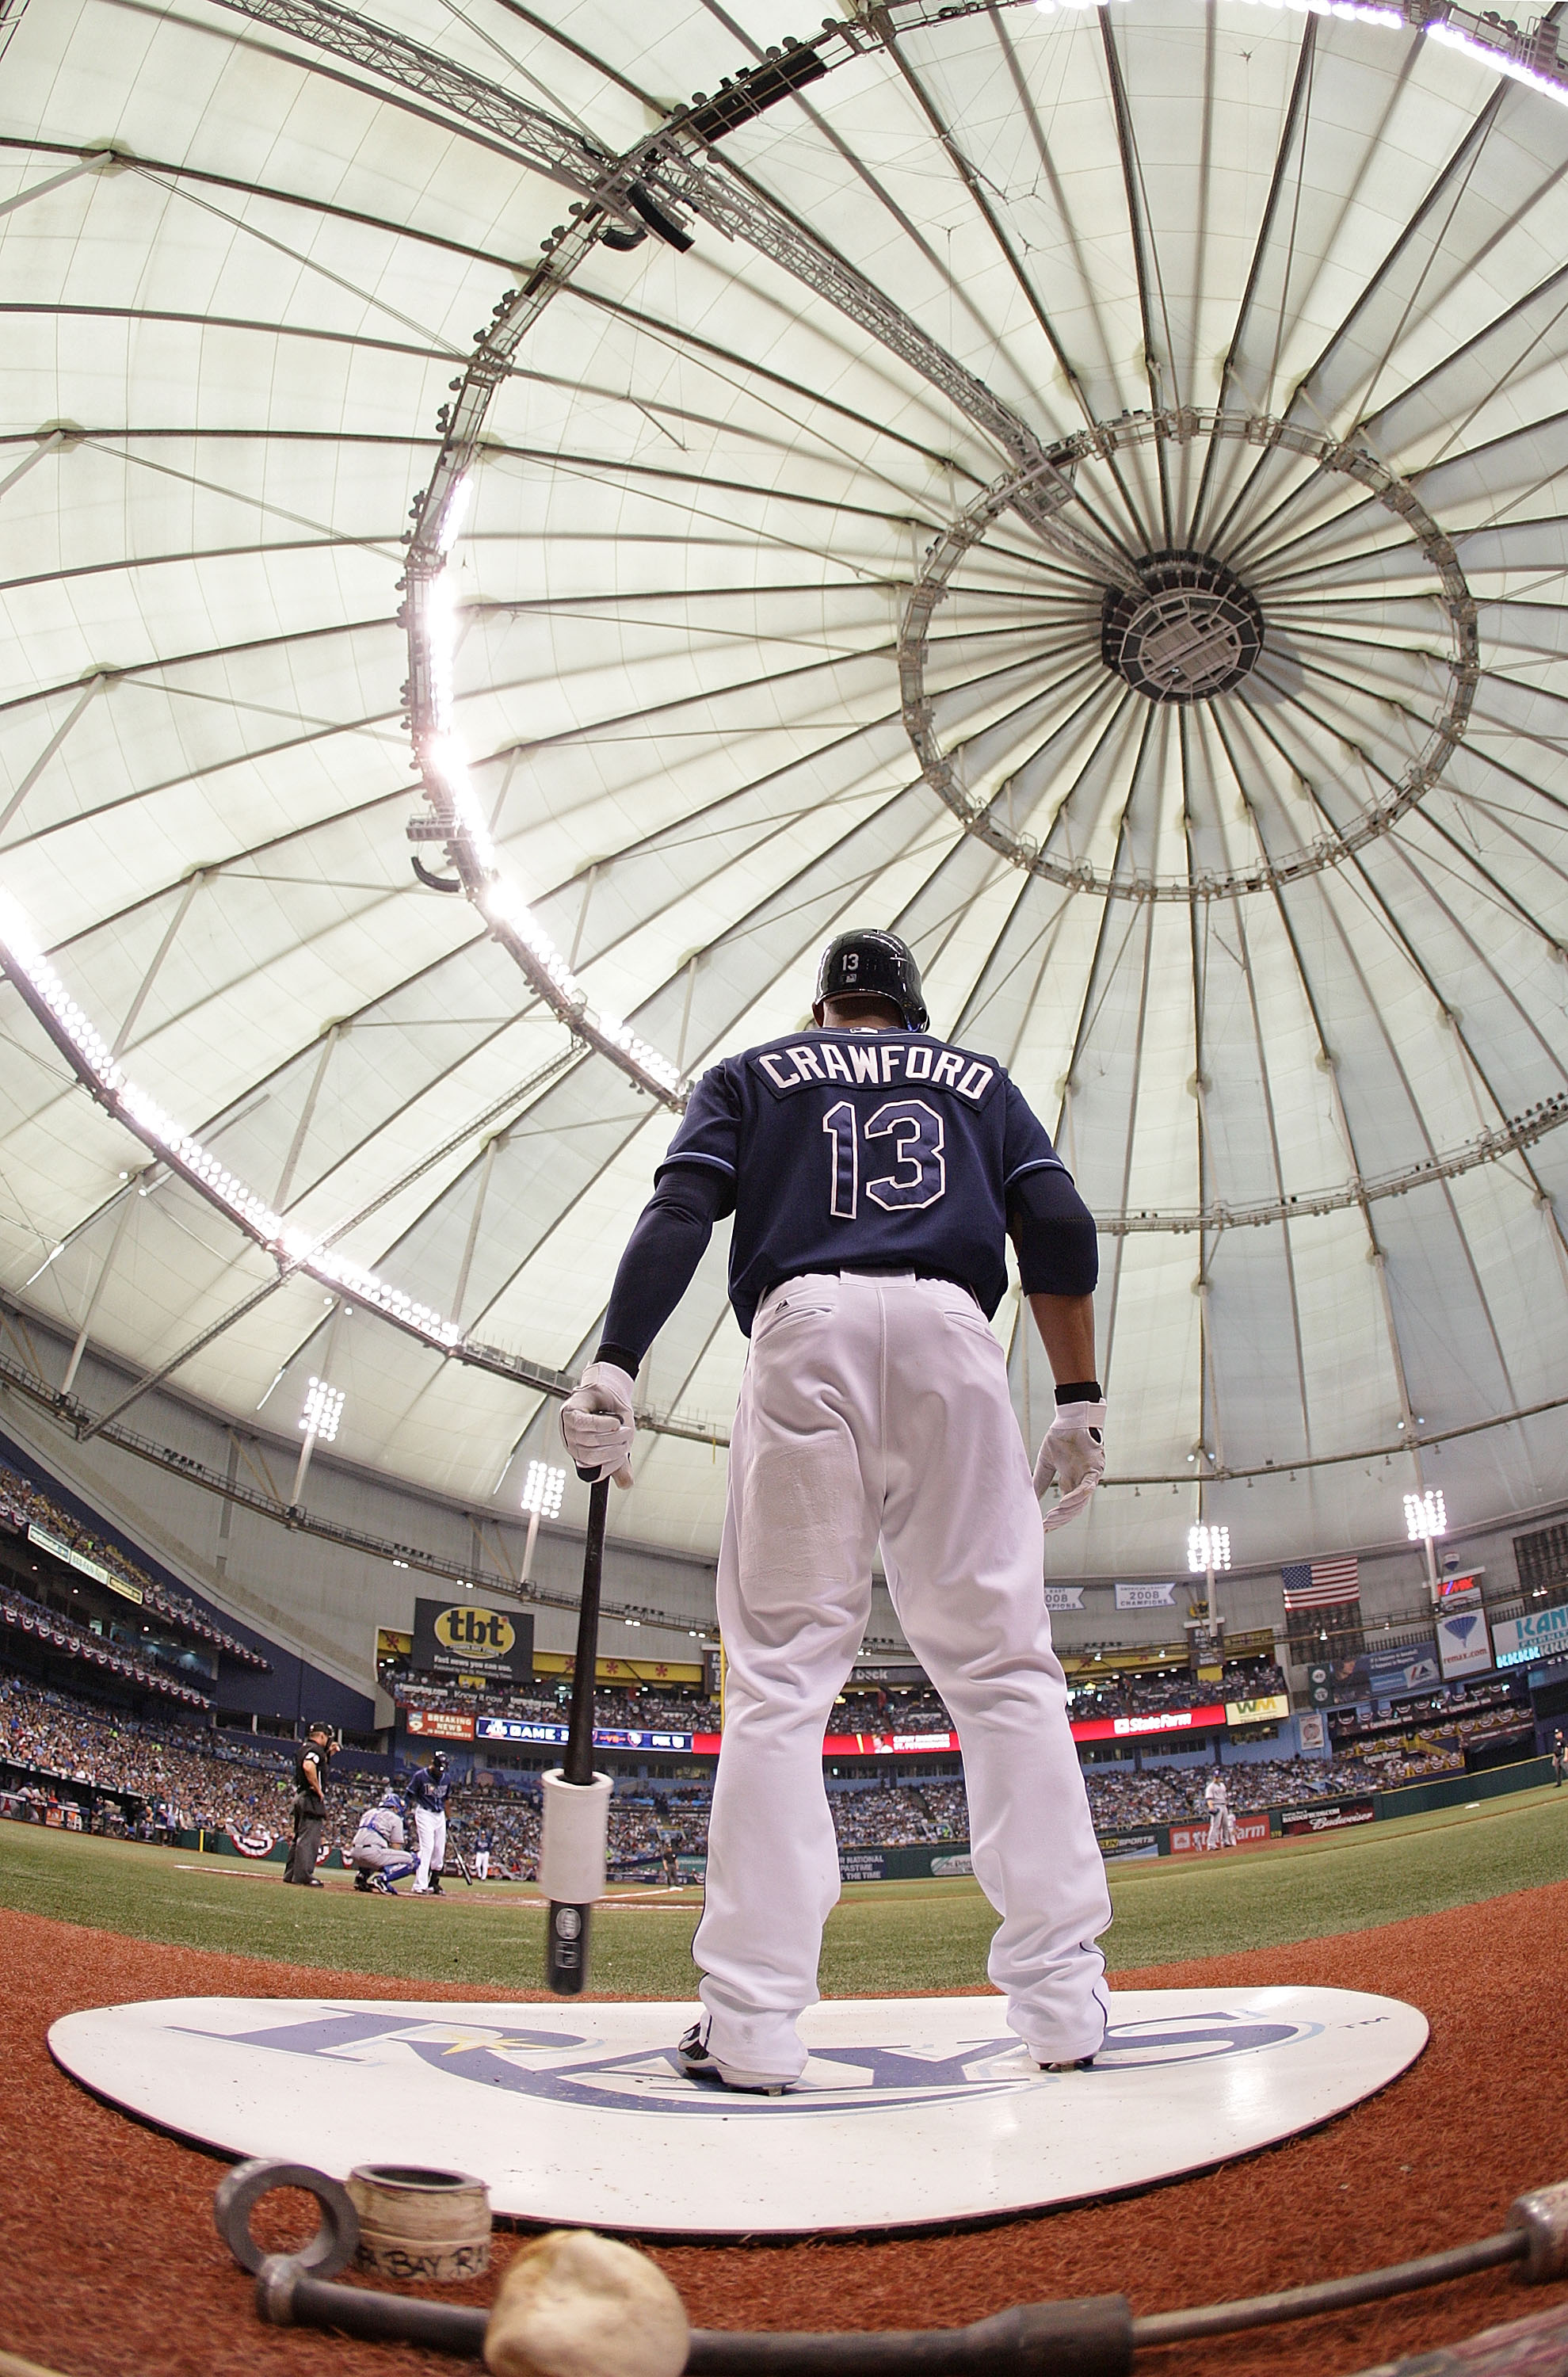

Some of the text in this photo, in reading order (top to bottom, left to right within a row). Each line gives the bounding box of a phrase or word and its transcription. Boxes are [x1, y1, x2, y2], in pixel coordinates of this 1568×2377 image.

[842, 953, 859, 971] 13
[759, 1044, 994, 1100] CRAWFORD
[822, 1099, 946, 1219] 13
[1046, 1594, 1068, 1603] 008
[1130, 1591, 1159, 1601] 2008
[447, 1610, 504, 1646] tbt
[1444, 1648, 1487, 1663] remax.com
[454, 1690, 476, 1700] Know
[1237, 1698, 1277, 1714] WM
[409, 1720, 423, 1732] 9
[427, 1713, 471, 1726] BREAKING
[1129, 1713, 1192, 1732] State Farm
[437, 1723, 462, 1732] NEWS
[509, 1726, 555, 1741] GAME
[1310, 1812, 1373, 1830] Budweiser
[1235, 1825, 1265, 1840] arm
[1118, 1835, 1154, 1846] SPORTS
[847, 1855, 883, 1864] NATIONAL
[384, 2249, 442, 2278] BAY
